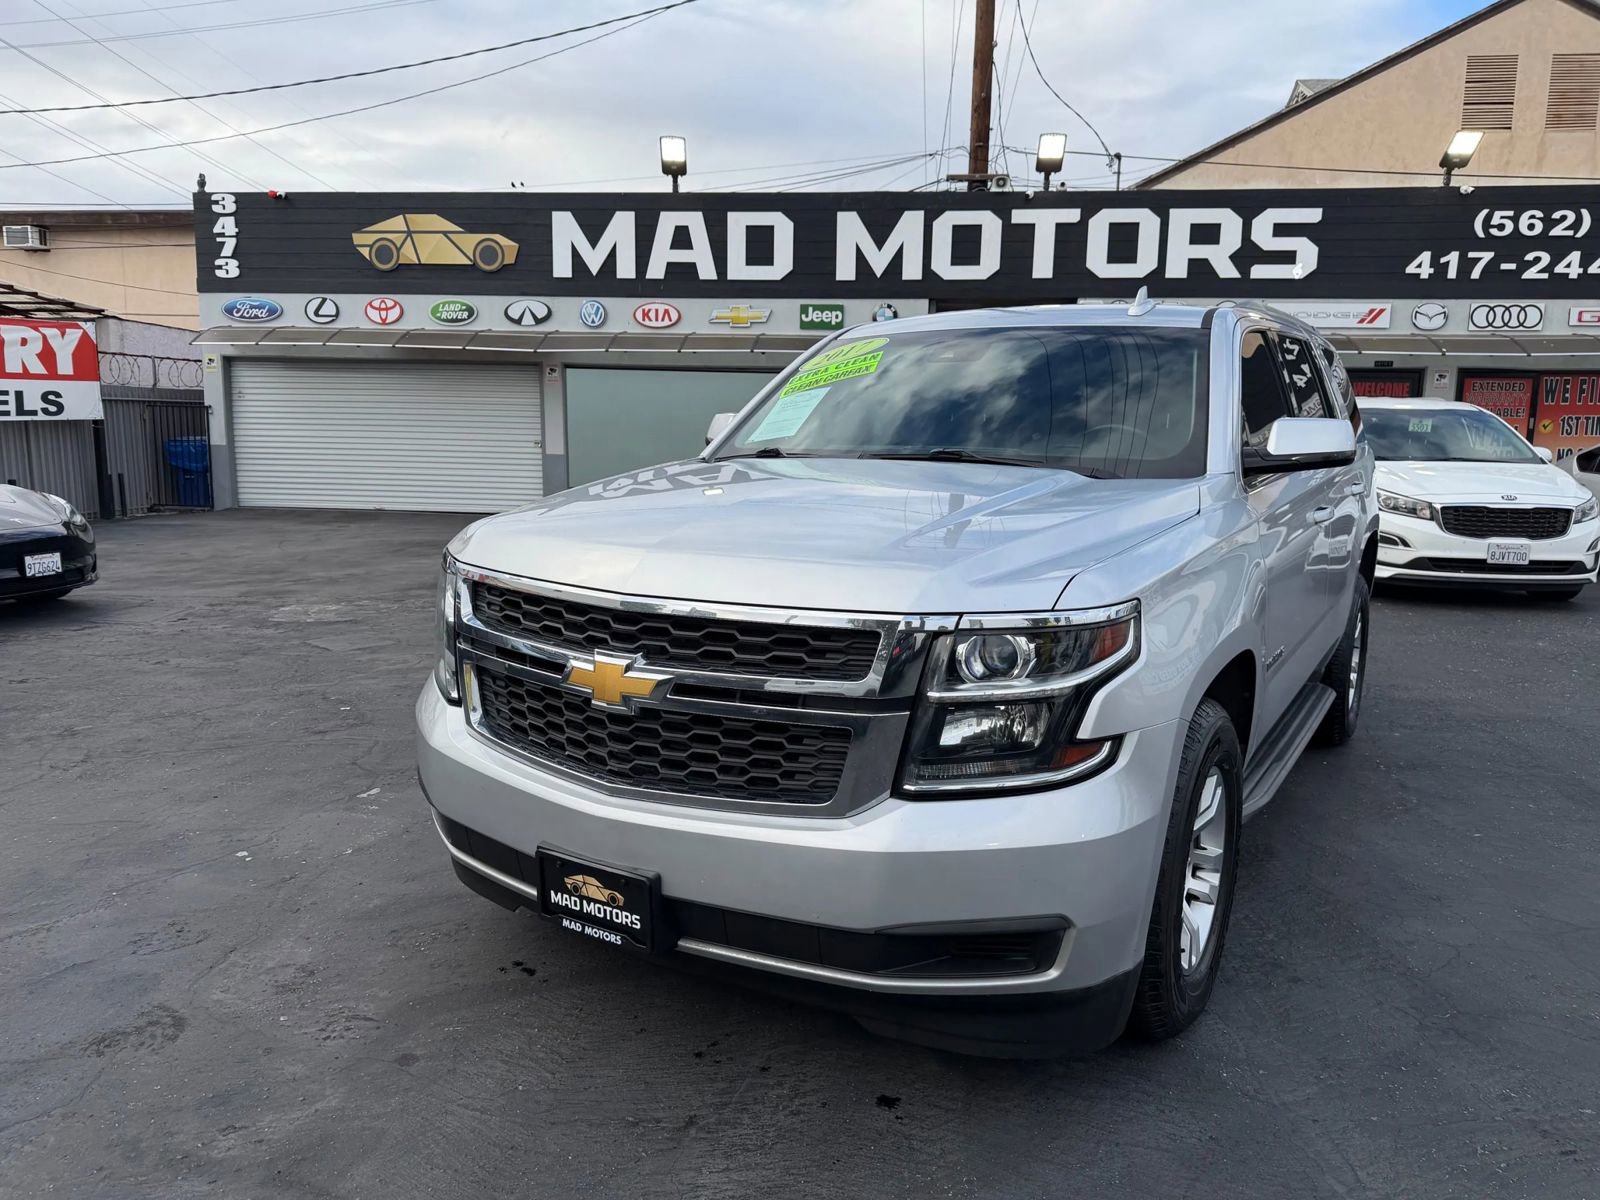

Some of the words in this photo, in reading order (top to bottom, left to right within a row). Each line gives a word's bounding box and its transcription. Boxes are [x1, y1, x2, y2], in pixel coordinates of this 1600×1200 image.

[1474, 208, 1591, 238] (562)
[211, 193, 240, 278] 3473
[551, 210, 794, 281] MAD
[836, 208, 1323, 280] MOTORS
[232, 299, 269, 318] Ford
[440, 311, 468, 320] ROVER
[641, 309, 672, 322] KIA
[801, 307, 842, 325] Jeep
[1287, 311, 1369, 319] ODGE
[790, 367, 829, 384] EXTRA
[835, 353, 880, 369] CLEAN
[784, 378, 821, 395] CLEAN
[823, 364, 872, 381] CARFAX
[1471, 381, 1526, 392] EXTENDED
[1354, 383, 1409, 397] WELCOME
[1543, 377, 1572, 405] WE
[1576, 377, 1600, 405] FI
[1487, 407, 1525, 417] ABLE!
[1560, 415, 1582, 437] 1ST
[1490, 551, 1527, 562] 8JVT700
[550, 890, 580, 911] MAD
[583, 899, 641, 930] MOTORS
[562, 918, 582, 932] MAD
[584, 925, 622, 945] MOTORS
